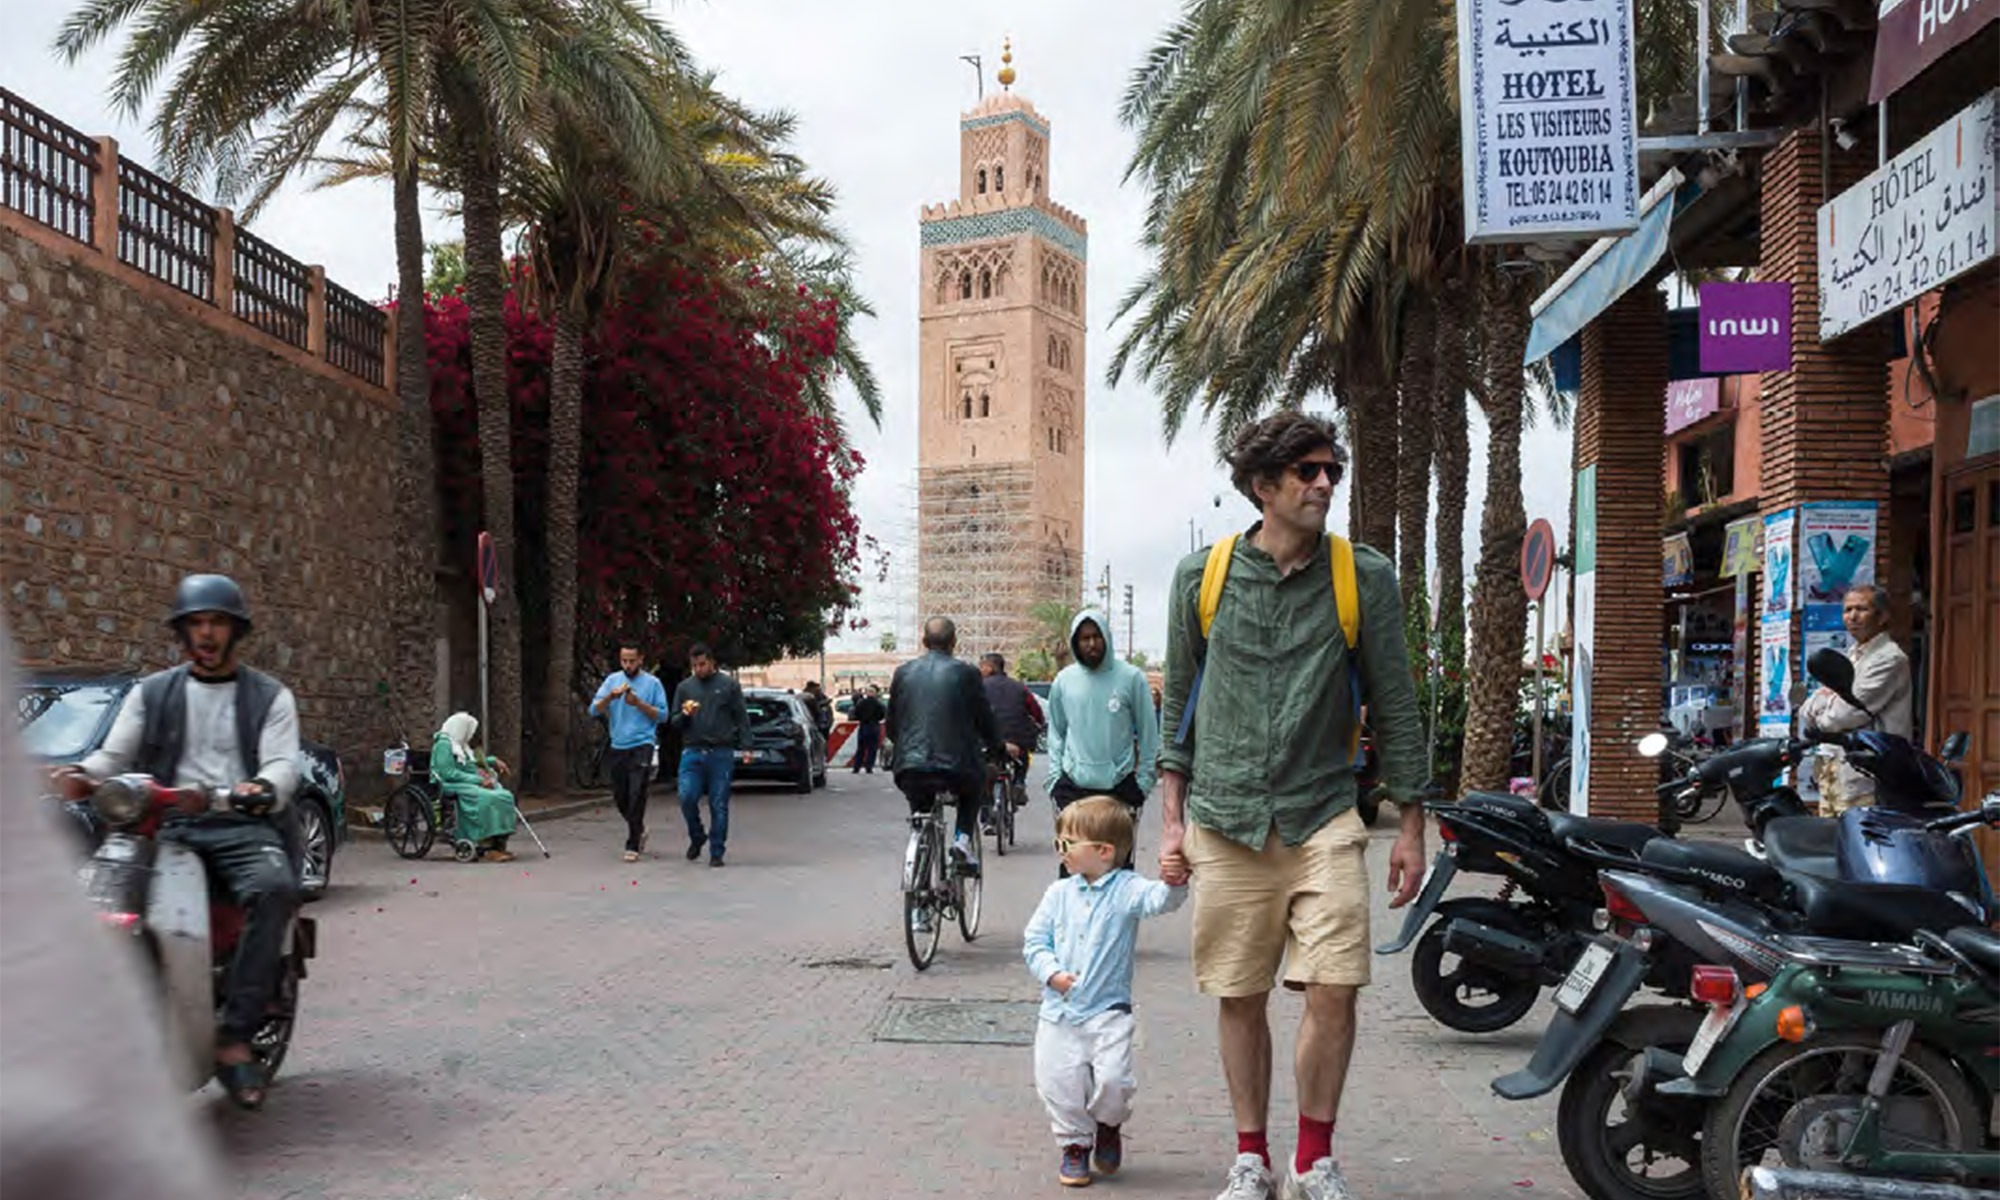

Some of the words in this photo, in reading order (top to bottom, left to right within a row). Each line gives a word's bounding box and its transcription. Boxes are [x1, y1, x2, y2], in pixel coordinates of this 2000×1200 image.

[1494, 17, 1610, 58] الكتبية
[1917, 0, 1969, 46] HO
[1502, 69, 1605, 100] HOTEL
[1497, 112, 1525, 140] LES
[1530, 108, 1612, 138] VISITEURS
[1499, 144, 1614, 178] KOUTOUBIA
[1549, 180, 1562, 205] 24
[1565, 180, 1579, 205] 42
[1581, 178, 1595, 204] 61
[1599, 178, 1612, 204] 14
[1870, 147, 1937, 220] HÔTEL
[1935, 163, 1987, 232] فندق
[1831, 221, 1885, 291] الكتبية
[1892, 208, 1926, 267] زوار
[1867, 989, 1943, 1013] YAMAHA
